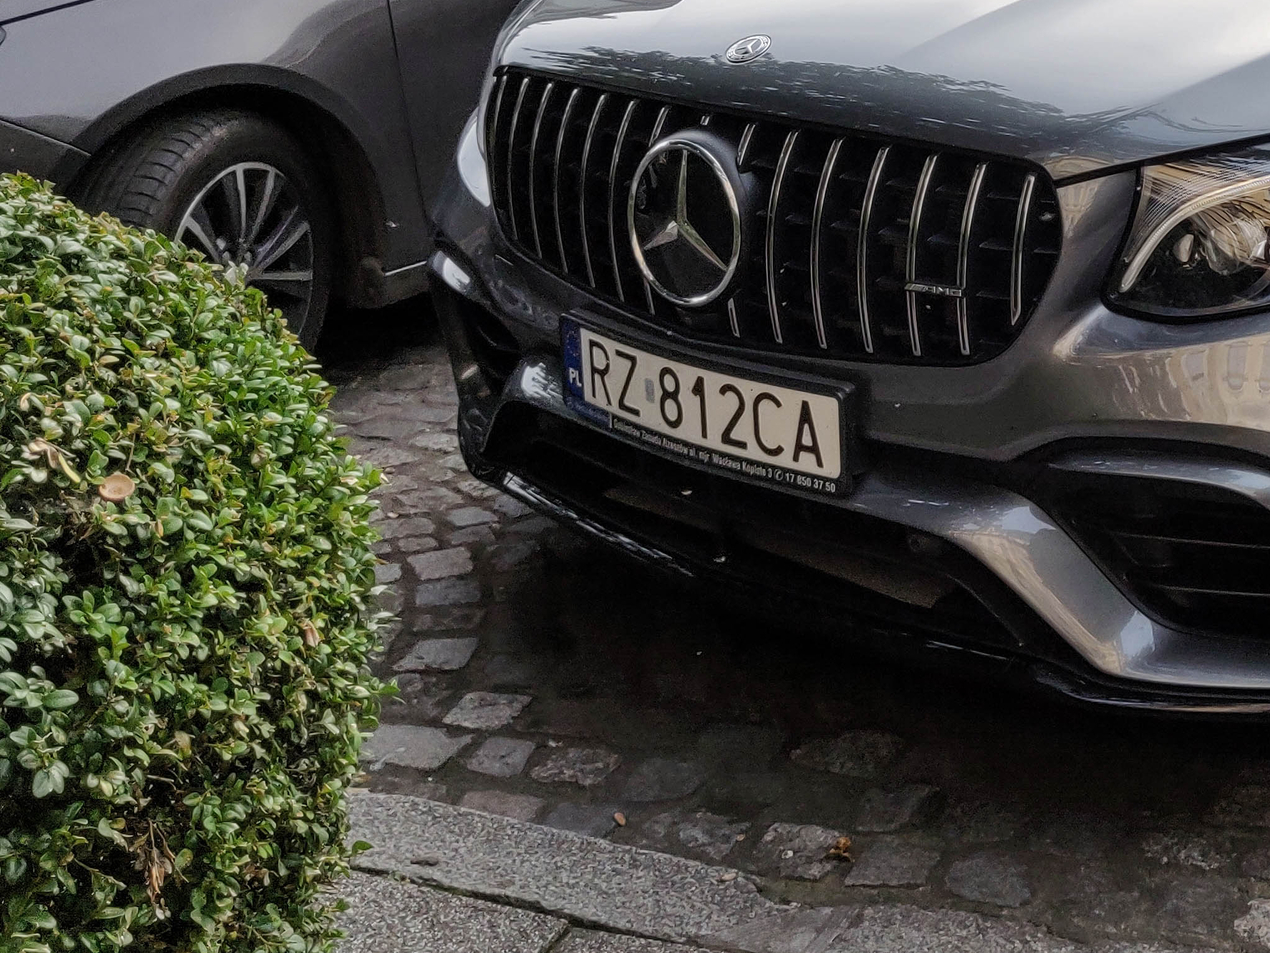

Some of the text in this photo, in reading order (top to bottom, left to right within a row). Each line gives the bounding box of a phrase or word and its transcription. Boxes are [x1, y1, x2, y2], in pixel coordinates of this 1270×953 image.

[568, 367, 582, 387] PL
[589, 338, 824, 469] RZ 812CA
[785, 472, 795, 483] 17
[813, 479, 824, 490] 37
[825, 482, 837, 493] 50
